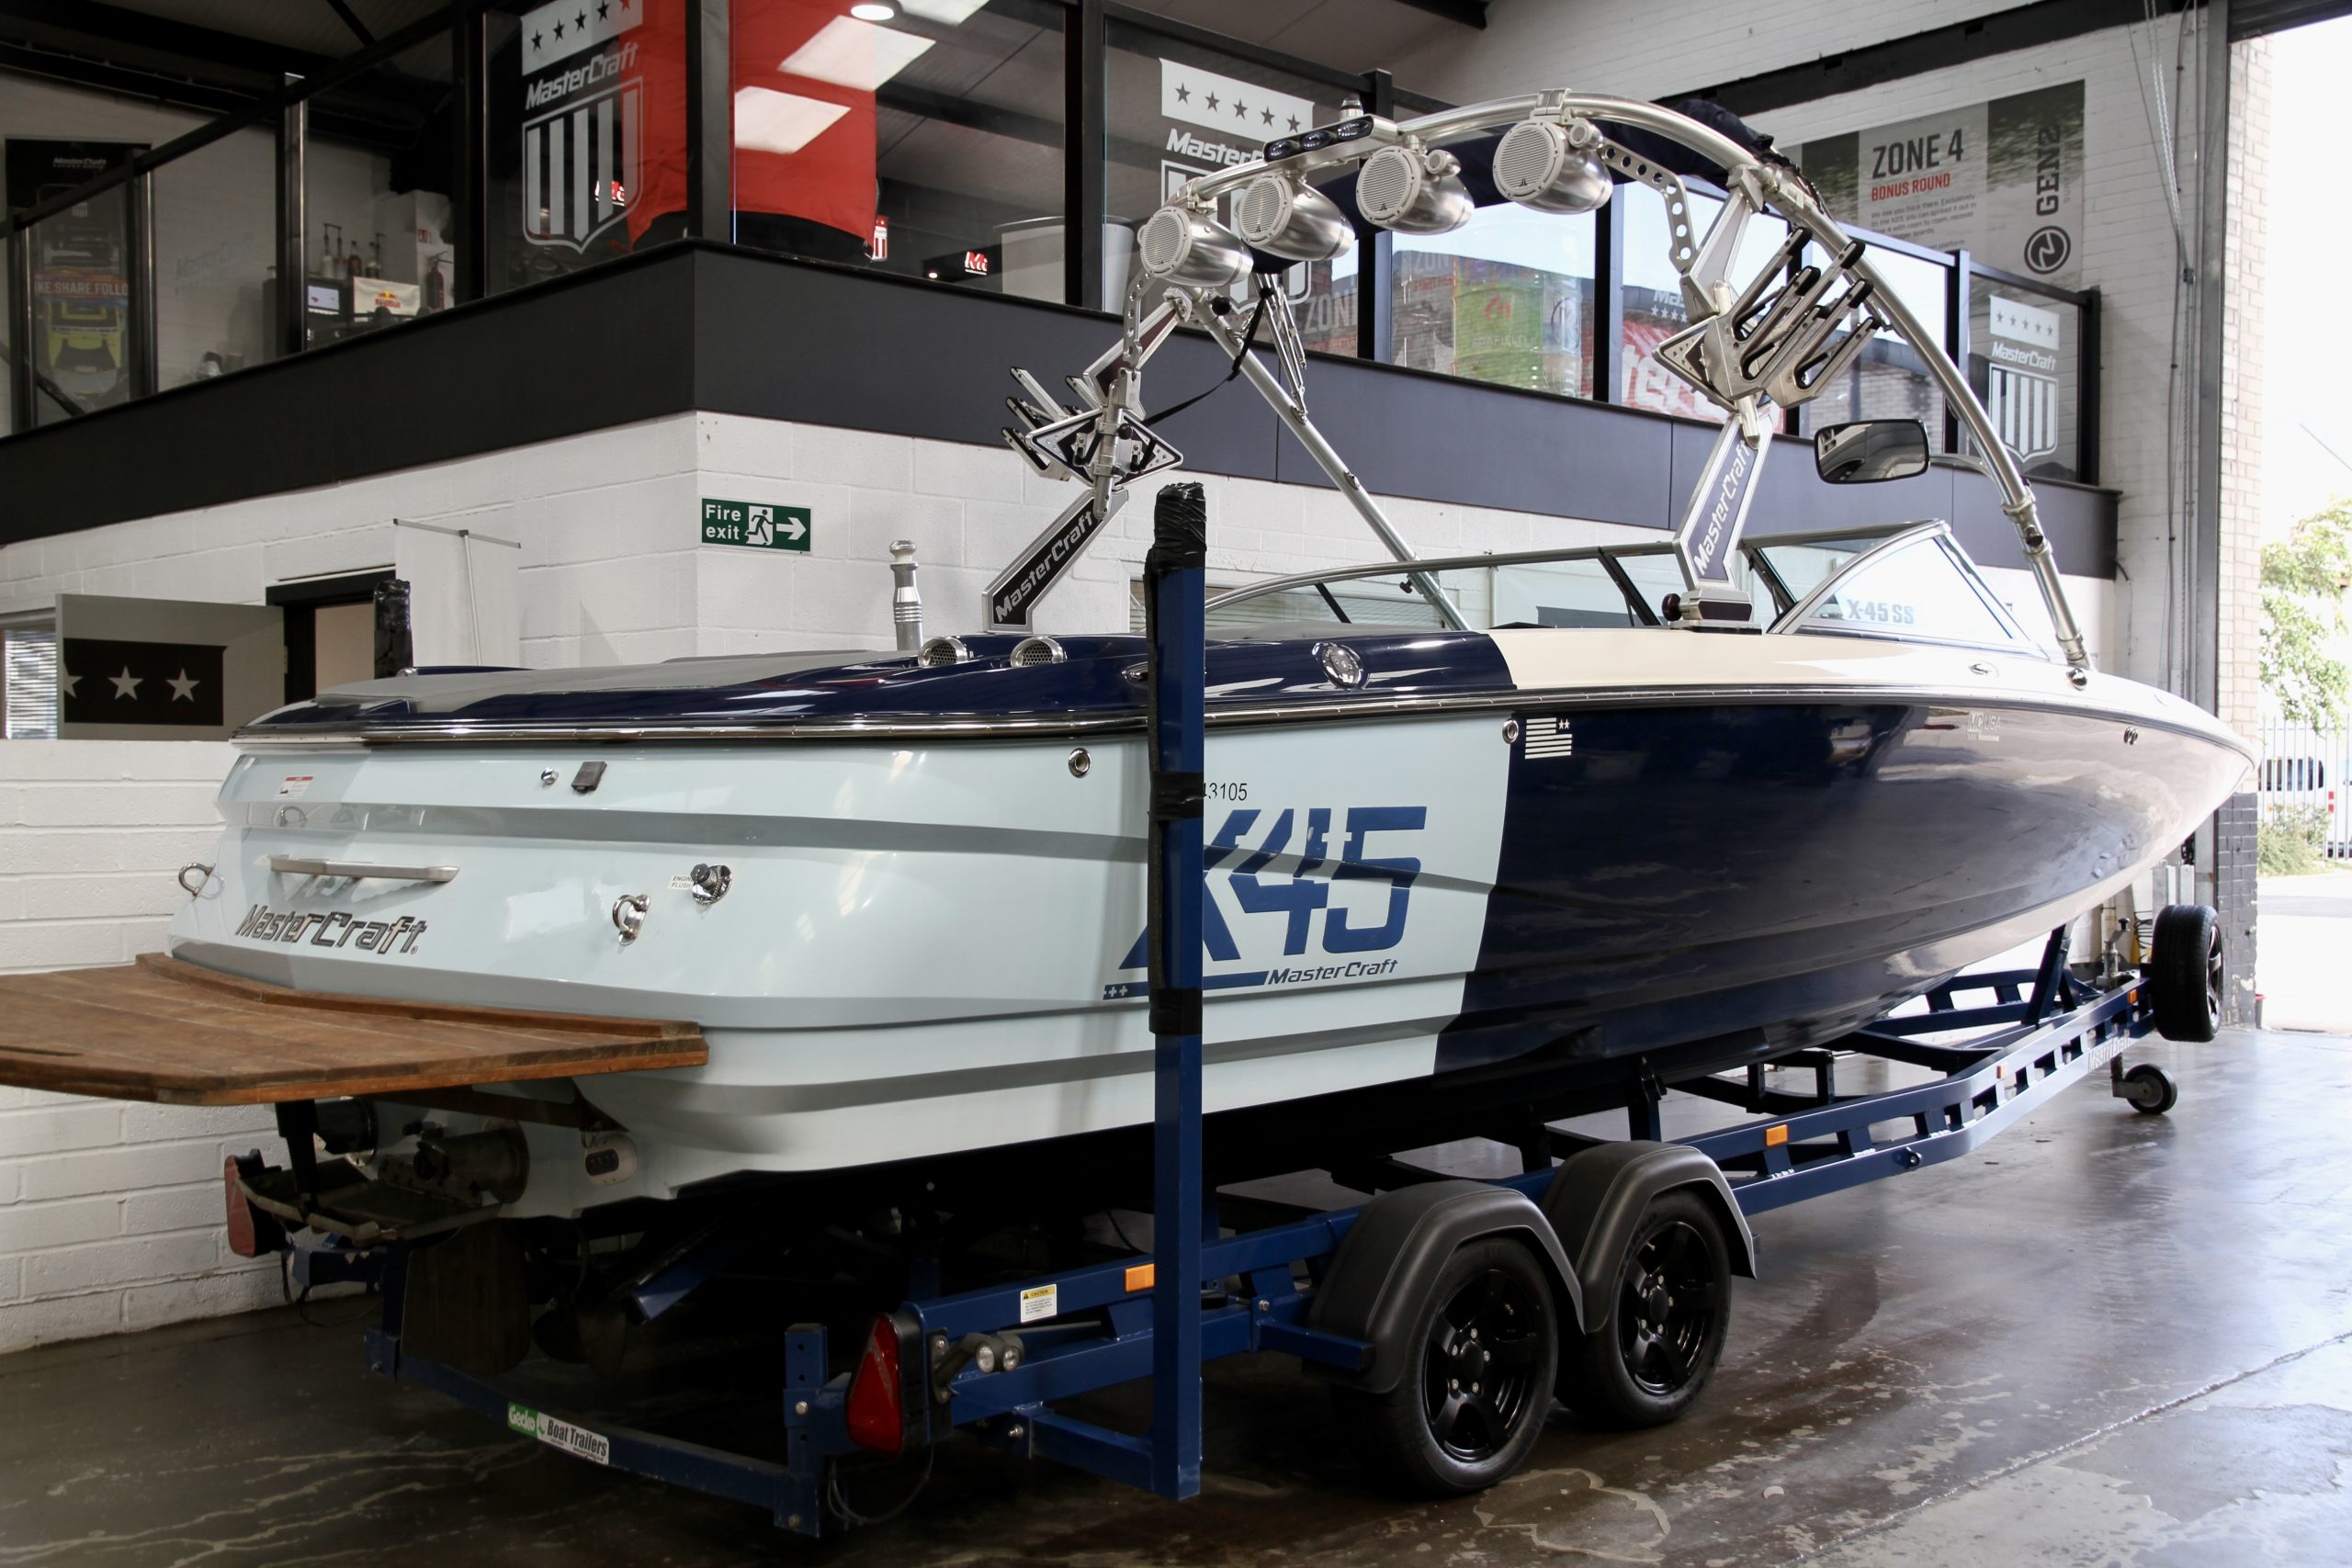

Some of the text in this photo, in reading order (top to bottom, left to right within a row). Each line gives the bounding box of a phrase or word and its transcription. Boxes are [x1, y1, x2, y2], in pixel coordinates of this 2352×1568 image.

[526, 42, 639, 110] MasterCraft
[1872, 129, 1963, 179] ZONE 4
[2036, 125, 2061, 216] GEN2
[1871, 173, 1951, 202] BONUS ROUND
[1992, 341, 2057, 371] MasterCraft
[706, 503, 741, 522] Fire
[706, 525, 740, 540] exit
[1693, 439, 1750, 576] MasterCraft
[995, 511, 1092, 623] MasterCraft
[1847, 599, 1915, 625] X-45 SS
[235, 904, 427, 954] MasterCraft
[1268, 958, 1397, 986] MasterCraft
[508, 1404, 536, 1432] Gecko
[548, 1418, 569, 1442] Boat
[570, 1427, 607, 1457] Trailers
